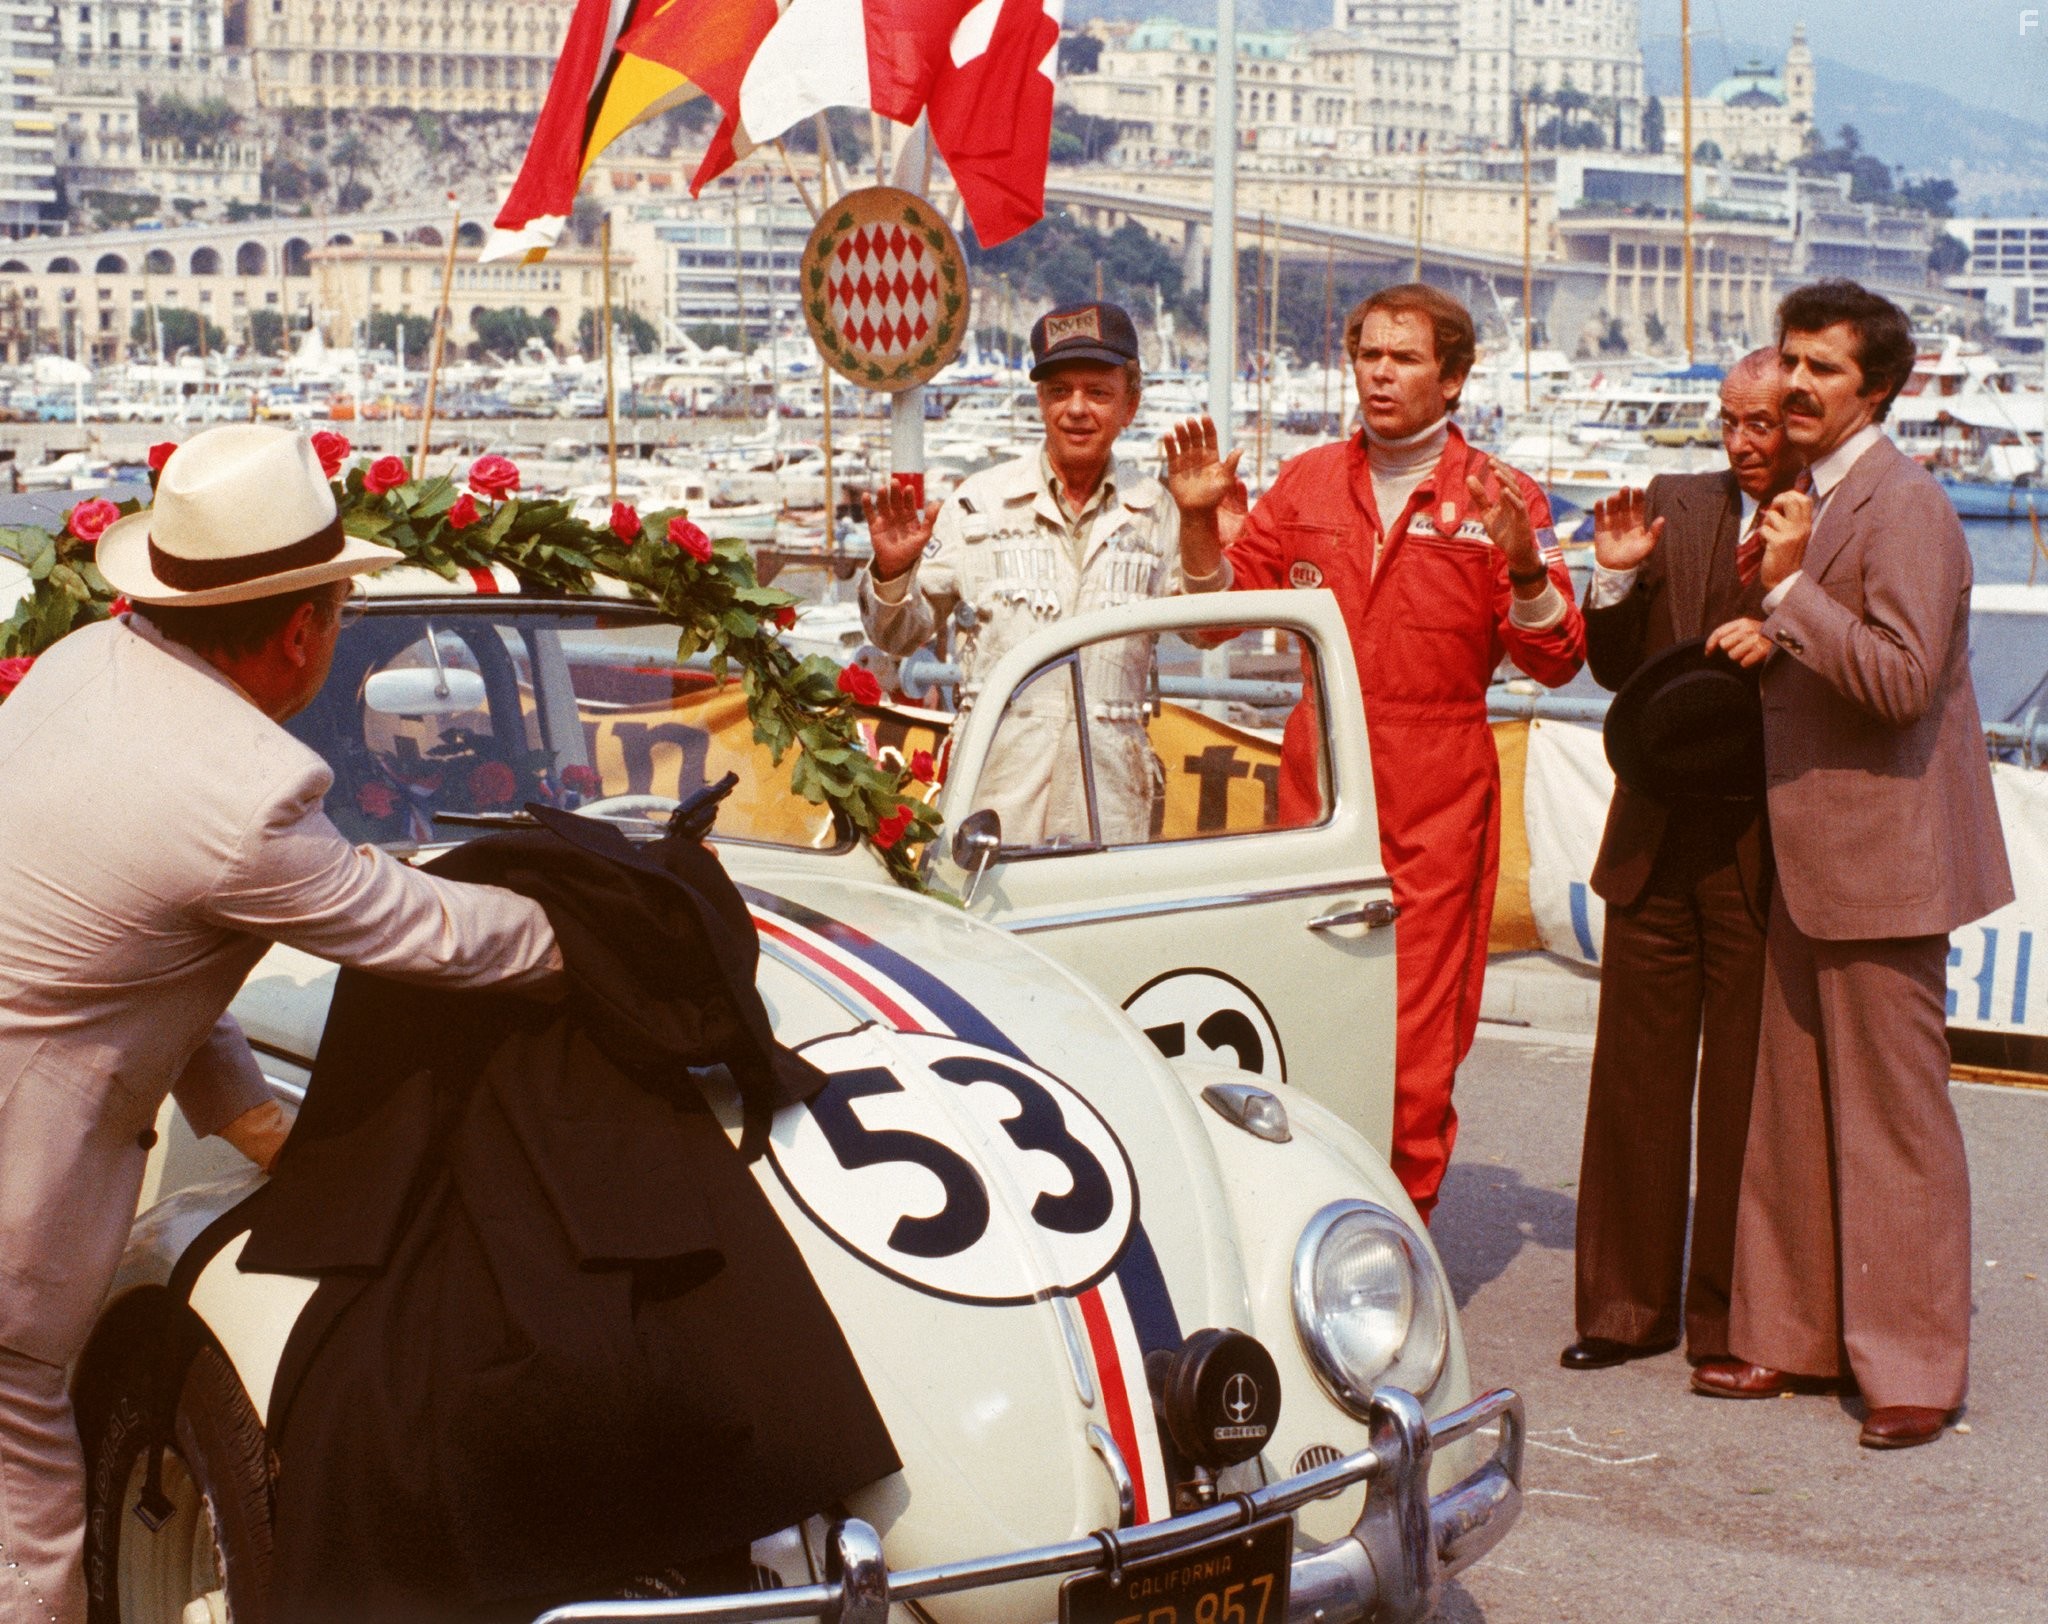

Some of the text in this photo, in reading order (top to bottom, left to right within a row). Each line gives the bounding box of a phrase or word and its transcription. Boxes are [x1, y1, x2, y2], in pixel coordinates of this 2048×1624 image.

[1293, 566, 1316, 583] BELL
[803, 1056, 1114, 1258] 53
[1129, 1555, 1232, 1600] CALIFORNIA
